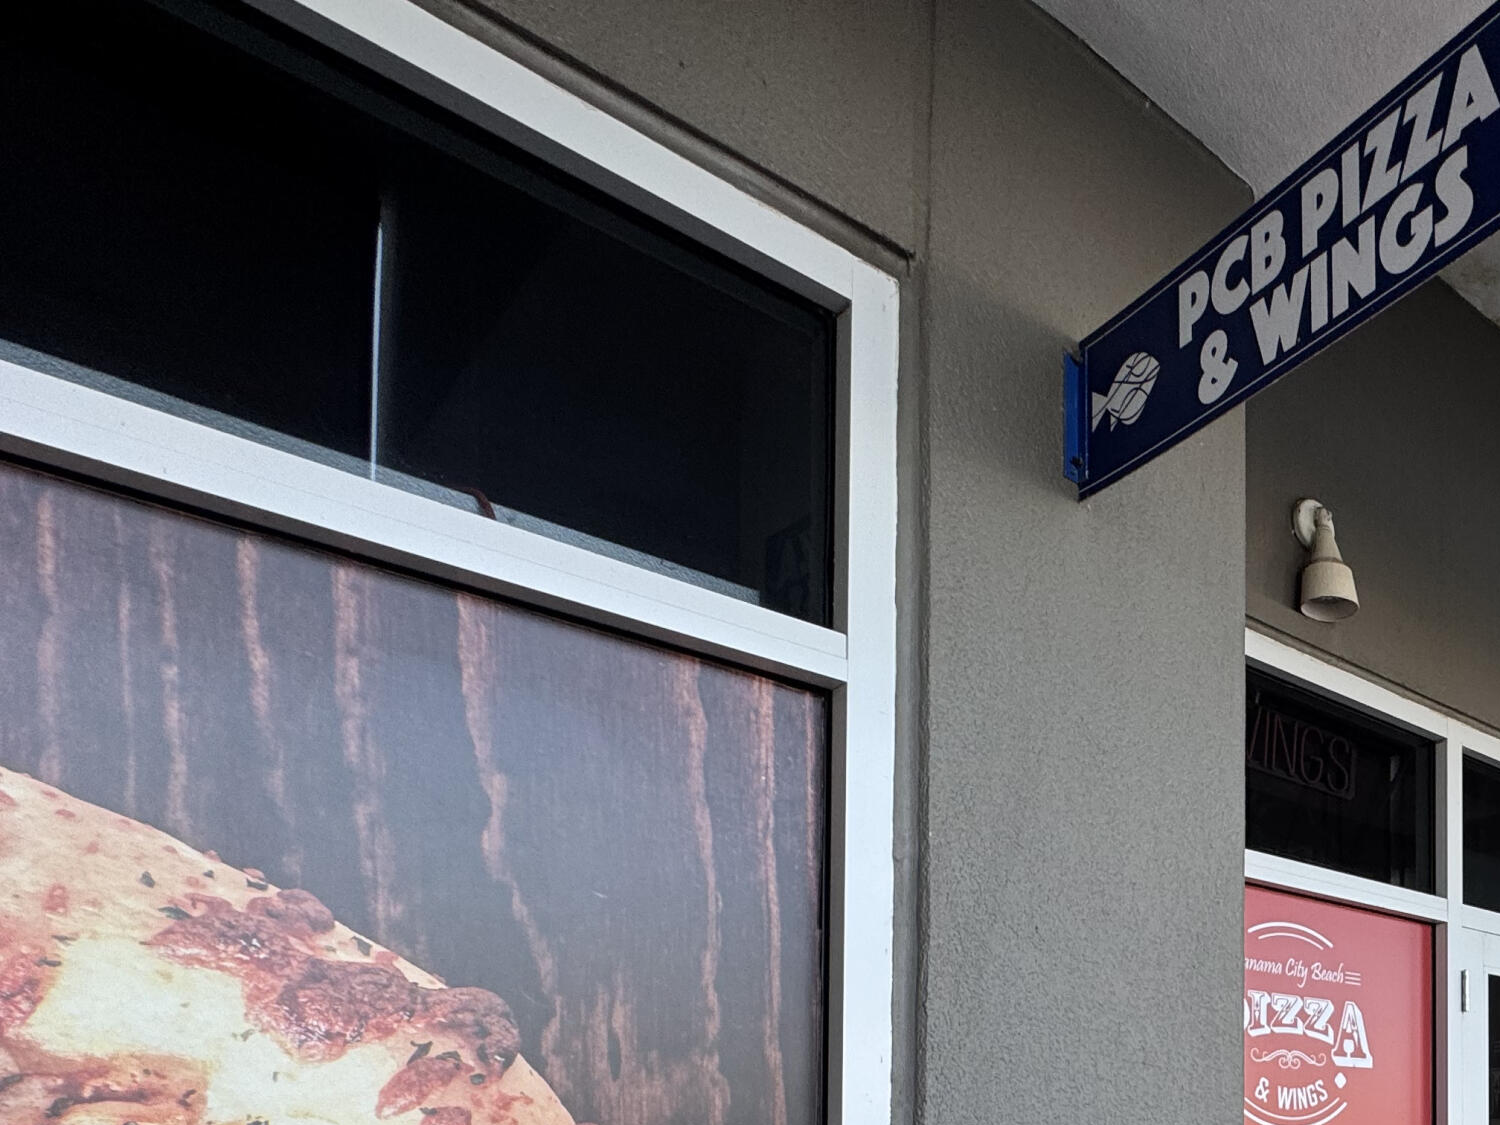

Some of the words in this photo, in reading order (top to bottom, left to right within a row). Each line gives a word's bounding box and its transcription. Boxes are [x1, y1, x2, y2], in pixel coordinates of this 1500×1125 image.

[1178, 209, 1286, 349] PCB
[1300, 43, 1500, 258] PIZZA
[1197, 330, 1238, 405] &
[1249, 145, 1474, 366] WINGS
[1285, 958, 1308, 988] City
[1311, 962, 1344, 983] Beach
[1244, 989, 1373, 1068] IZZA
[1255, 1077, 1269, 1102] &
[1277, 1079, 1329, 1110] WINGS
